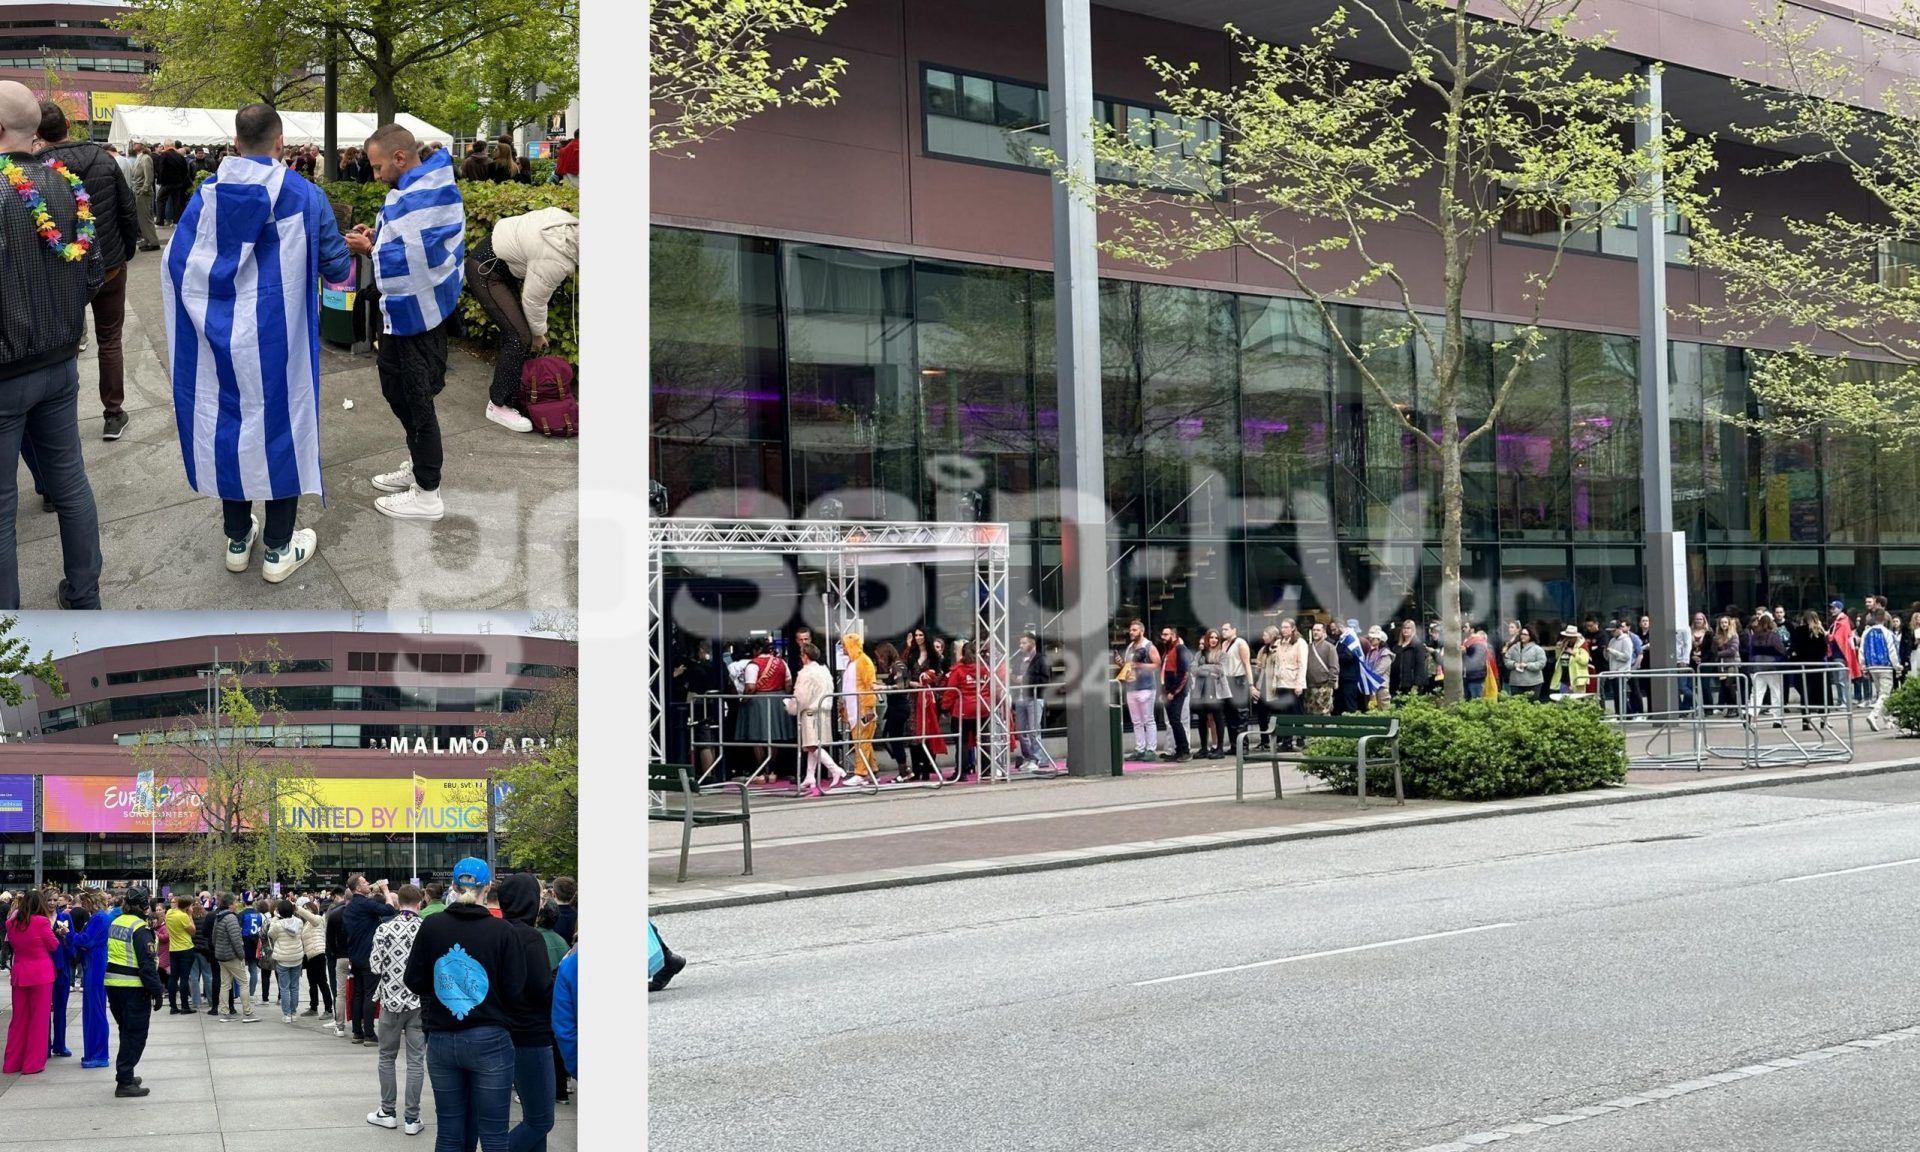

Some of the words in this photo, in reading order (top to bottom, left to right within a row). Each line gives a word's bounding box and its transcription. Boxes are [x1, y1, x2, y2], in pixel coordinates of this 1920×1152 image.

[281, 807, 364, 829] UNITED
[371, 807, 399, 829] BY
[405, 806, 482, 829] MUSIC
[250, 918, 258, 935] 5
